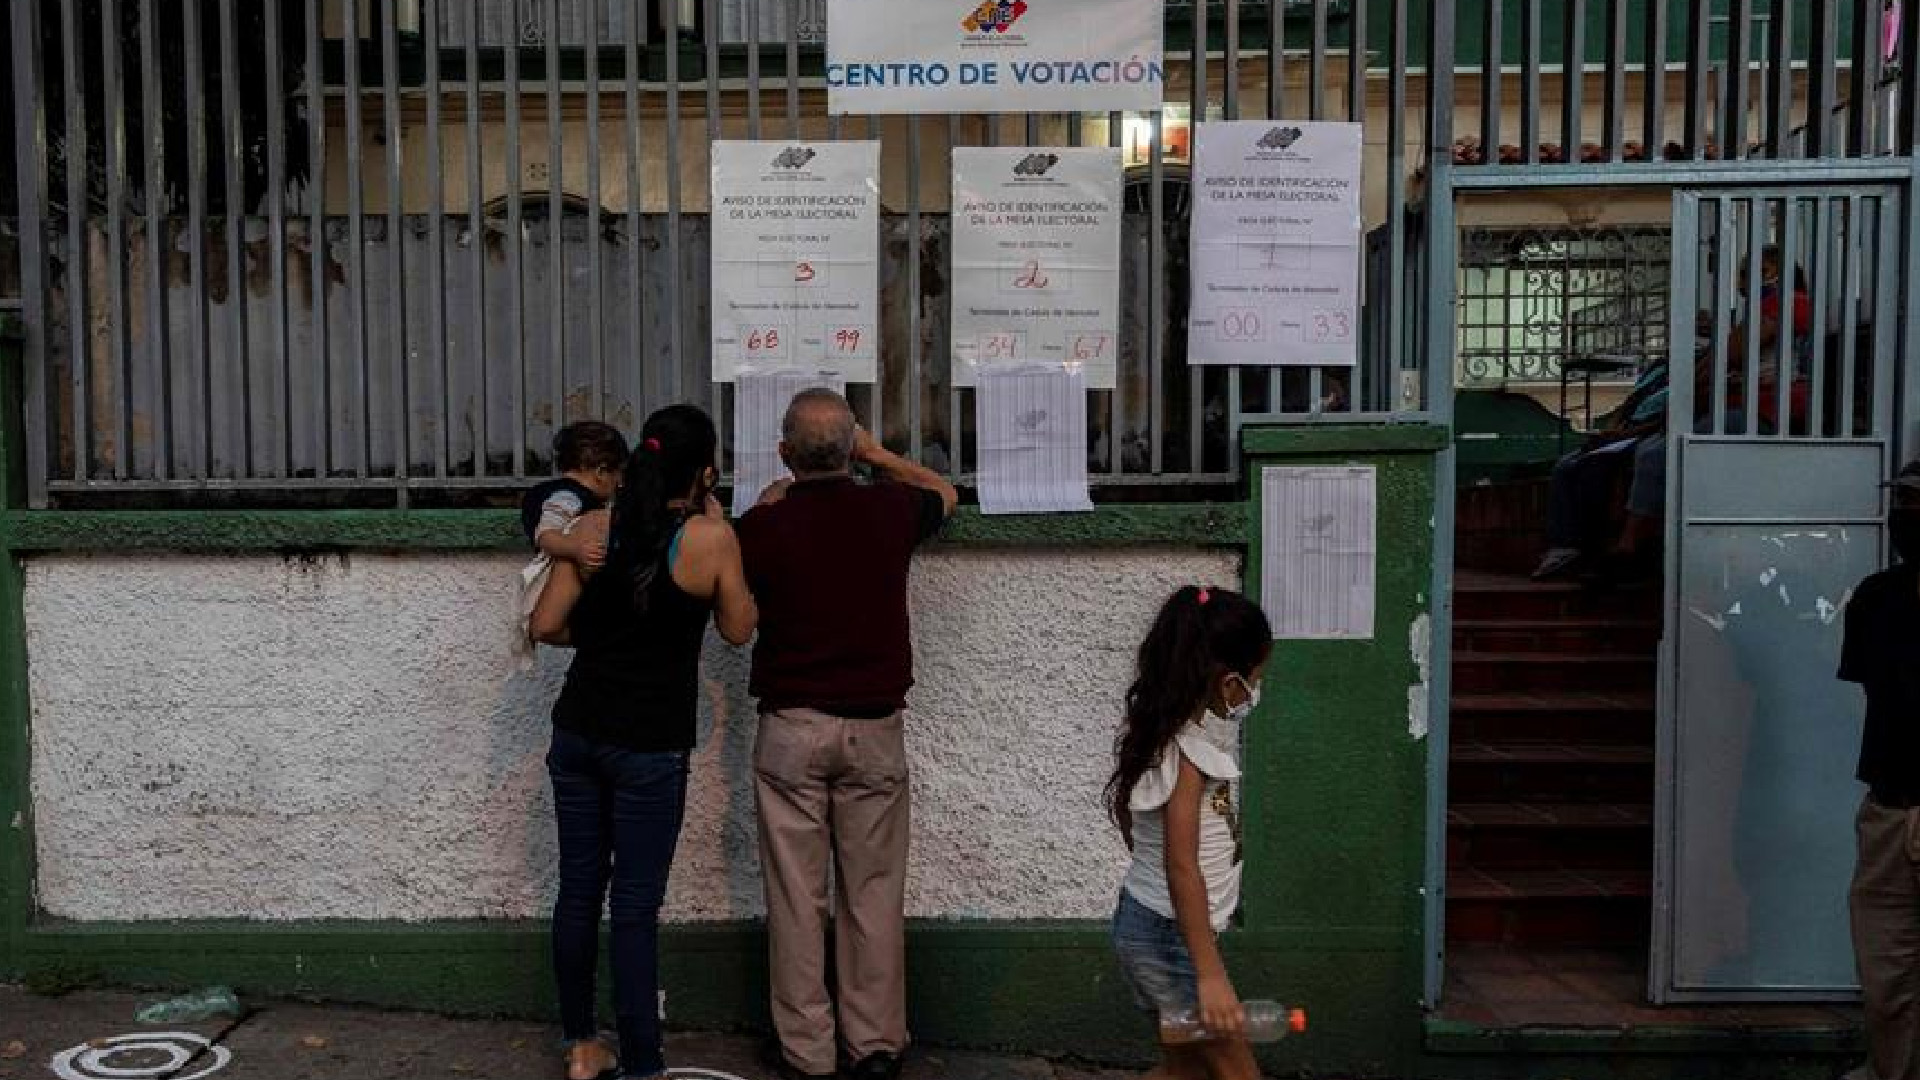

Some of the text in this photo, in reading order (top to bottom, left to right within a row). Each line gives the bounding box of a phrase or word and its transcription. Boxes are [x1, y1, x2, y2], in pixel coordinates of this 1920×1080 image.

[826, 55, 1165, 87] CENTRO DE VOTACIÓN
[1211, 191, 1341, 201] DE LA MESA ELECTORAL
[730, 209, 858, 219] DE LA MESA ELECTORAL
[971, 215, 1100, 226] DE LA MESA ELECTORAL
[794, 262, 816, 282] 3
[1013, 259, 1048, 289] 2
[1223, 311, 1261, 338] 00
[1313, 311, 1350, 338] 33
[747, 329, 778, 351] 68
[836, 329, 860, 352] 99
[1073, 336, 1106, 360] 67
